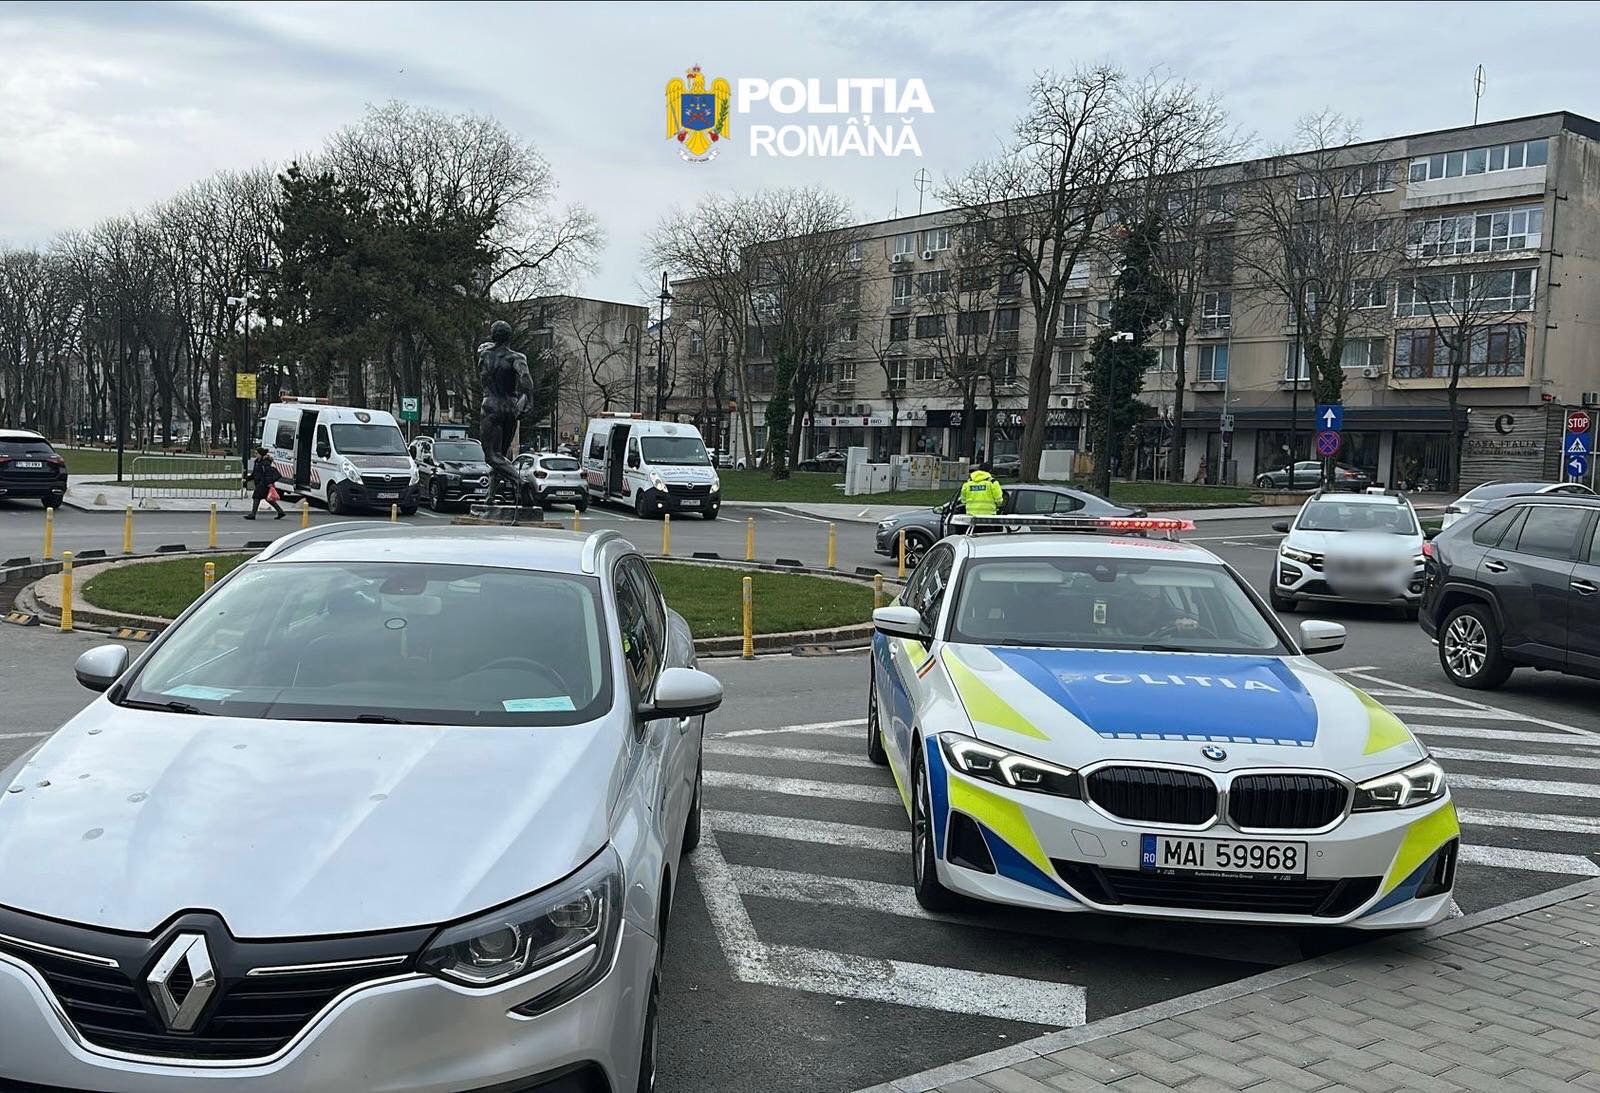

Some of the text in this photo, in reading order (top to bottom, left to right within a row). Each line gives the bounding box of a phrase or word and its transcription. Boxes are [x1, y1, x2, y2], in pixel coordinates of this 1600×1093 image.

[1568, 418, 1588, 428] STOP
[1143, 852, 1155, 864] RO
[1216, 843, 1297, 870] 59968
